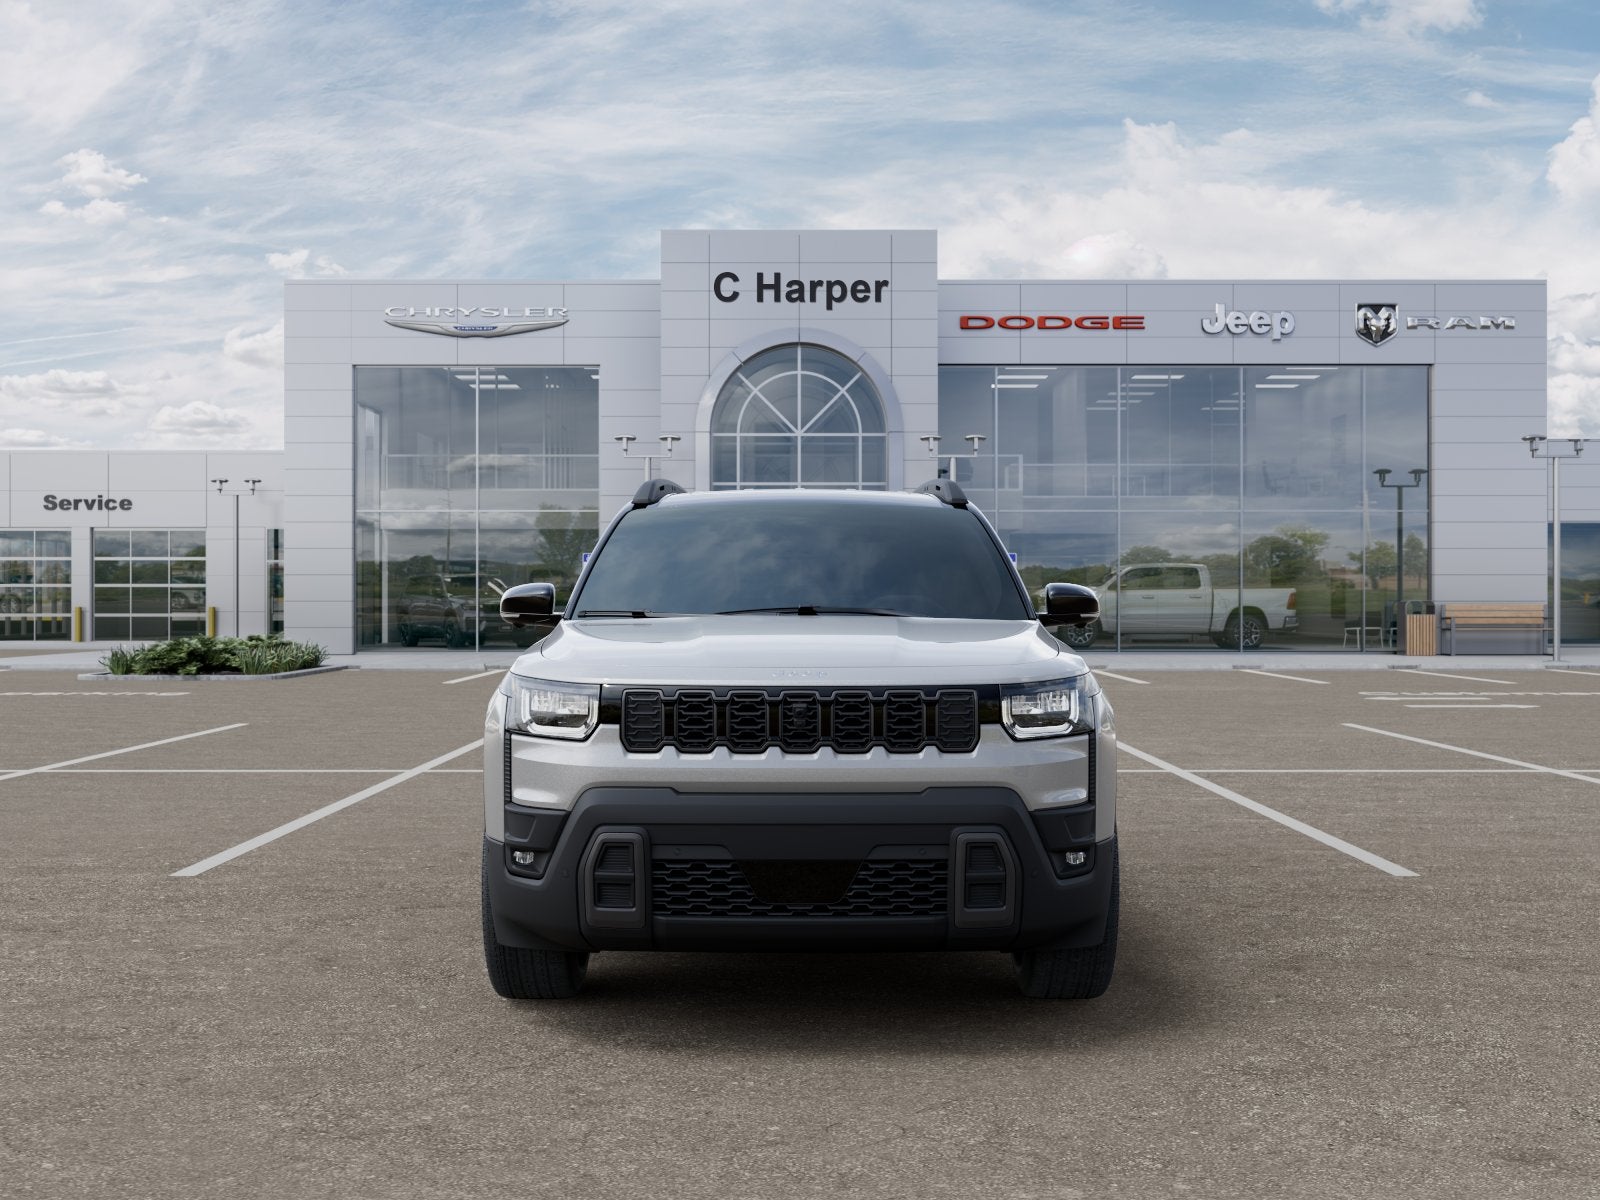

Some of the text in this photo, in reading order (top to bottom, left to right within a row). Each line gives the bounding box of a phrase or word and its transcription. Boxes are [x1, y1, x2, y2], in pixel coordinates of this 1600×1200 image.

[713, 271, 890, 310] C Harper
[384, 306, 569, 317] CHRYSLER
[959, 315, 1146, 329] DODGE
[1201, 303, 1295, 341] Jeep
[1406, 315, 1515, 329] RAM
[43, 494, 133, 511] Service
